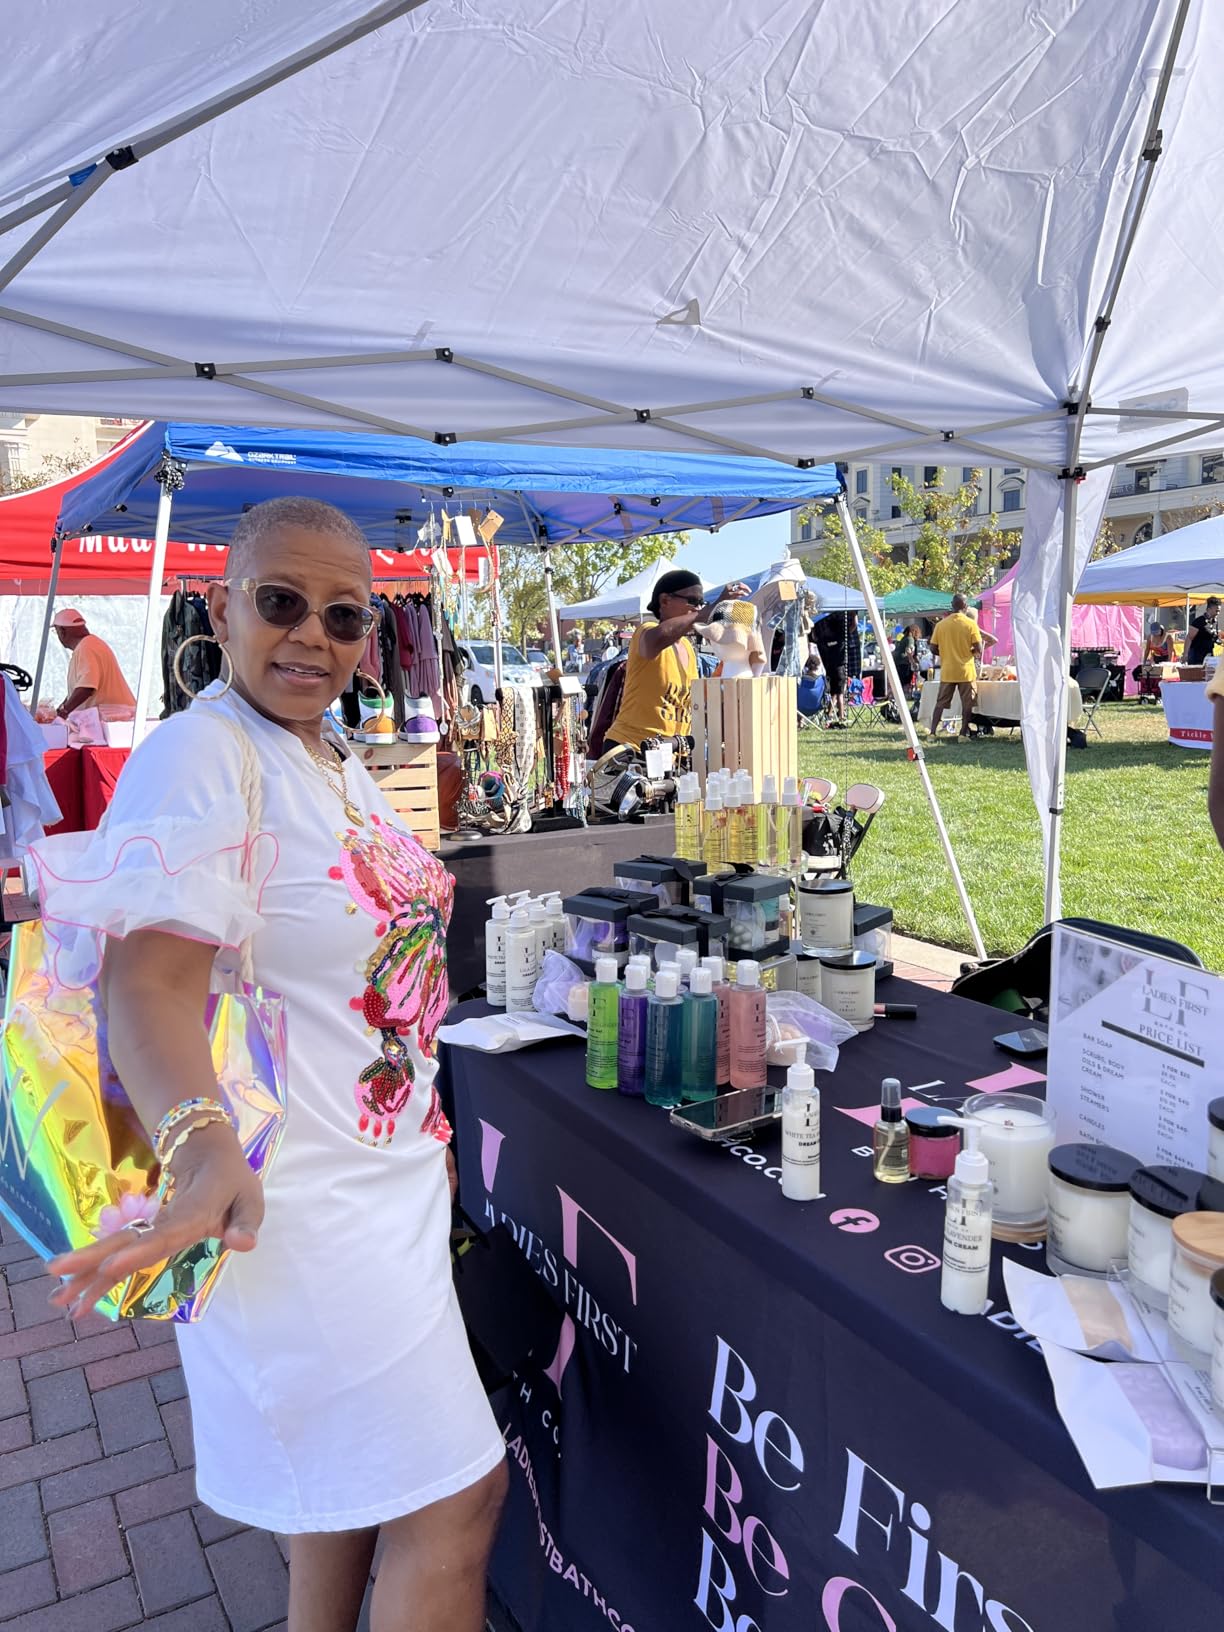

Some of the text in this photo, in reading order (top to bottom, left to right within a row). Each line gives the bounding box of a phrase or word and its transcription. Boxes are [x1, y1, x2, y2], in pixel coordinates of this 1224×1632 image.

[1142, 984, 1209, 1017] LADIES FIRST
[1139, 1023, 1203, 1057] PRICE LIST
[785, 1128, 804, 1139] WHITE
[953, 1241, 979, 1251] CREAM
[484, 1198, 638, 1374] DIES FIRST
[708, 1335, 804, 1491] Be
[703, 1432, 790, 1597] Be
[693, 1526, 762, 1632] B
